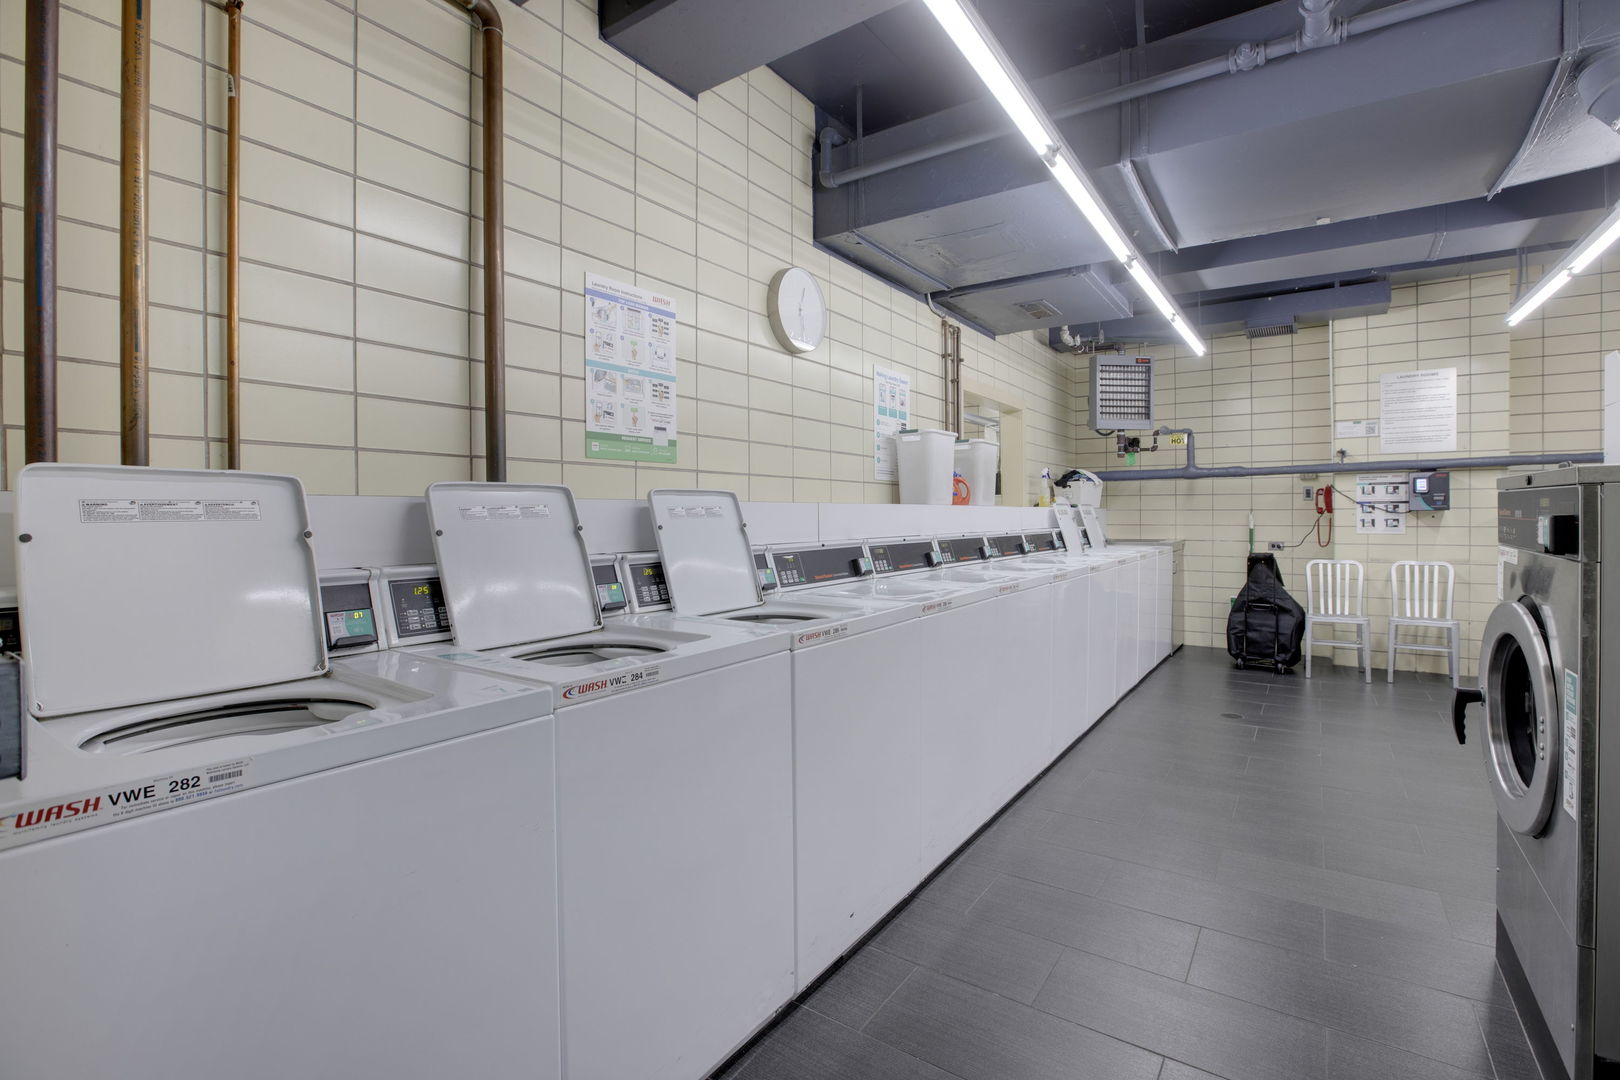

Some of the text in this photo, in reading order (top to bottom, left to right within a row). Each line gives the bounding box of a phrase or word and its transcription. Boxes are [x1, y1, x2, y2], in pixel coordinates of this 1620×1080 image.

[578, 680, 608, 694] WASH
[630, 672, 643, 682] 284
[15, 775, 201, 829] WASH VWE 282
